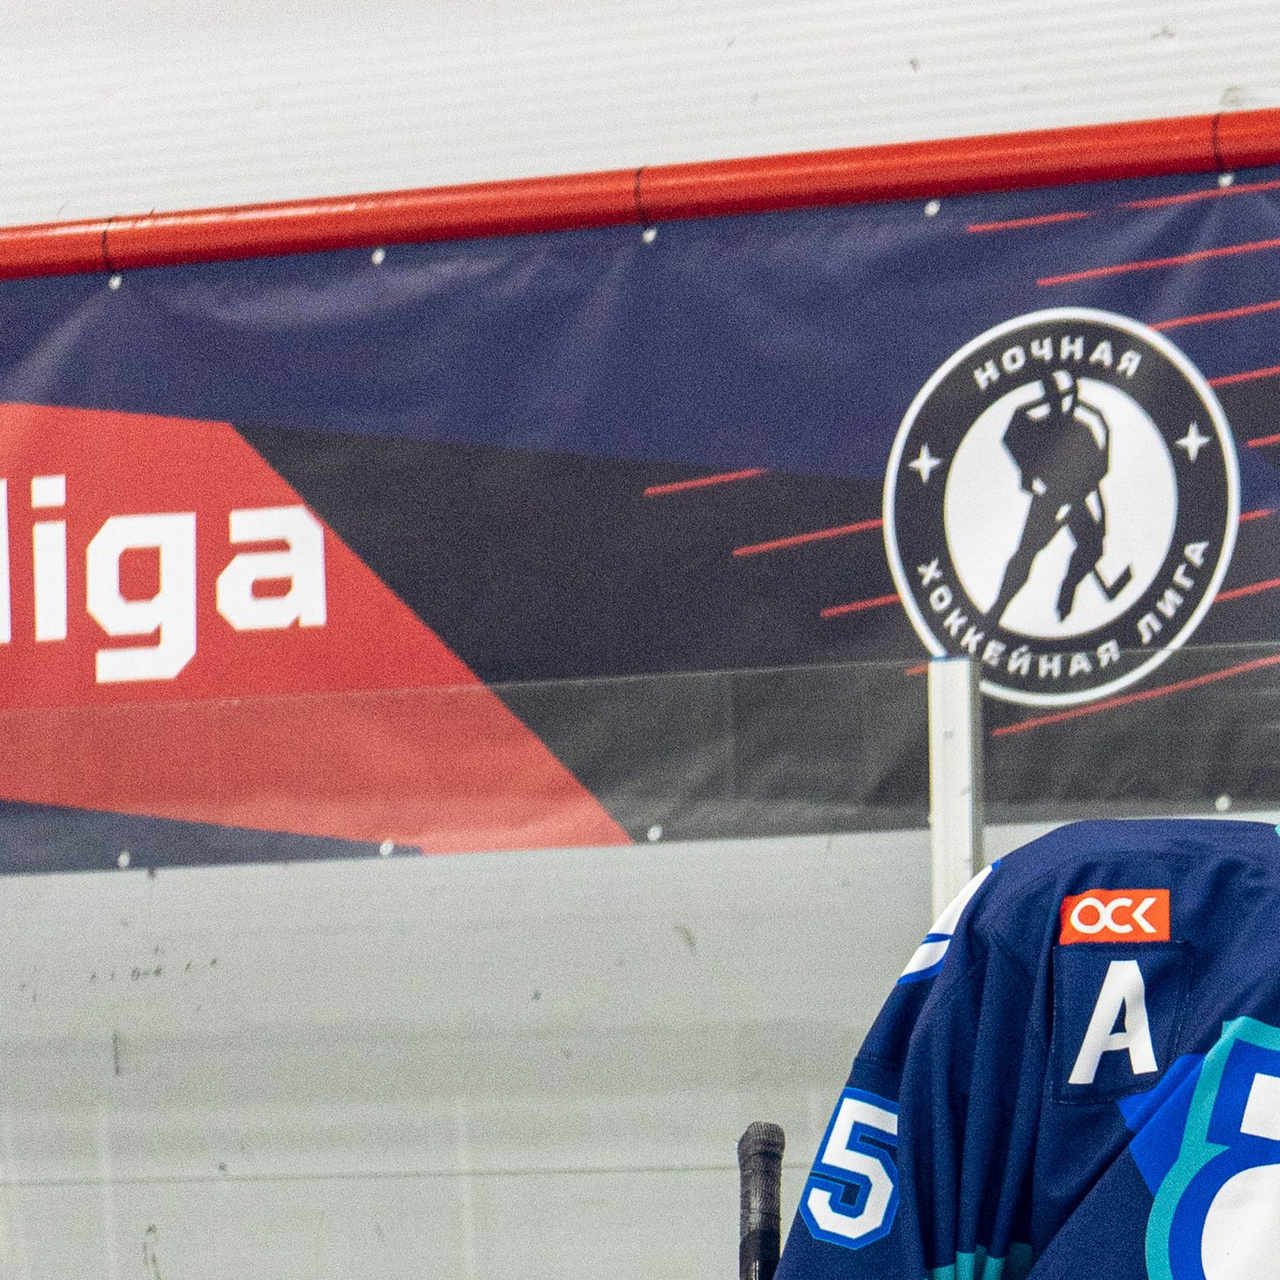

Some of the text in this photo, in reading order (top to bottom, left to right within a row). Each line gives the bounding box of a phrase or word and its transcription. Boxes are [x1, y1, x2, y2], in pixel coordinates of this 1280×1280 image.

[973, 335, 1142, 391] НОЧНАЯ
[917, 540, 1210, 680] ХОККЕЙНАЯ ЛИГА
